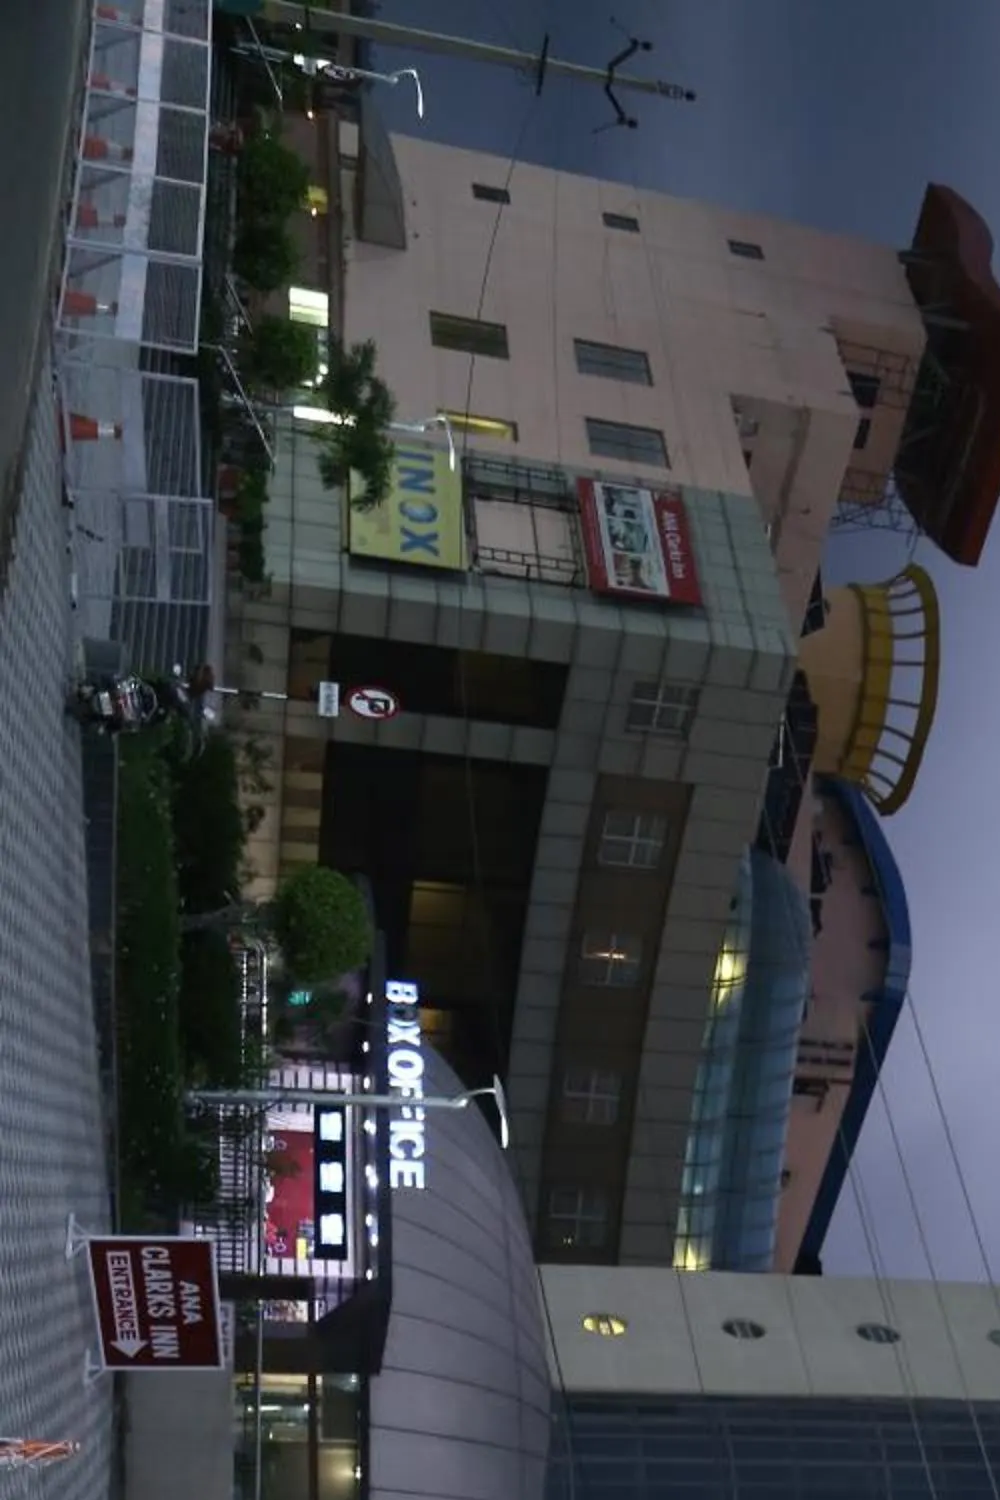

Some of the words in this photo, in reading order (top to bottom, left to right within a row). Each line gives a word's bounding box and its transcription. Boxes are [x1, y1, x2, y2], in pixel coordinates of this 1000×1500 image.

[397, 450, 440, 557] INOX
[386, 980, 420, 1046] BOX
[110, 1255, 136, 1341] ENTRANCE
[140, 1246, 176, 1318] CLARKS
[179, 1280, 204, 1325] ANA
[150, 1325, 180, 1359] INN
